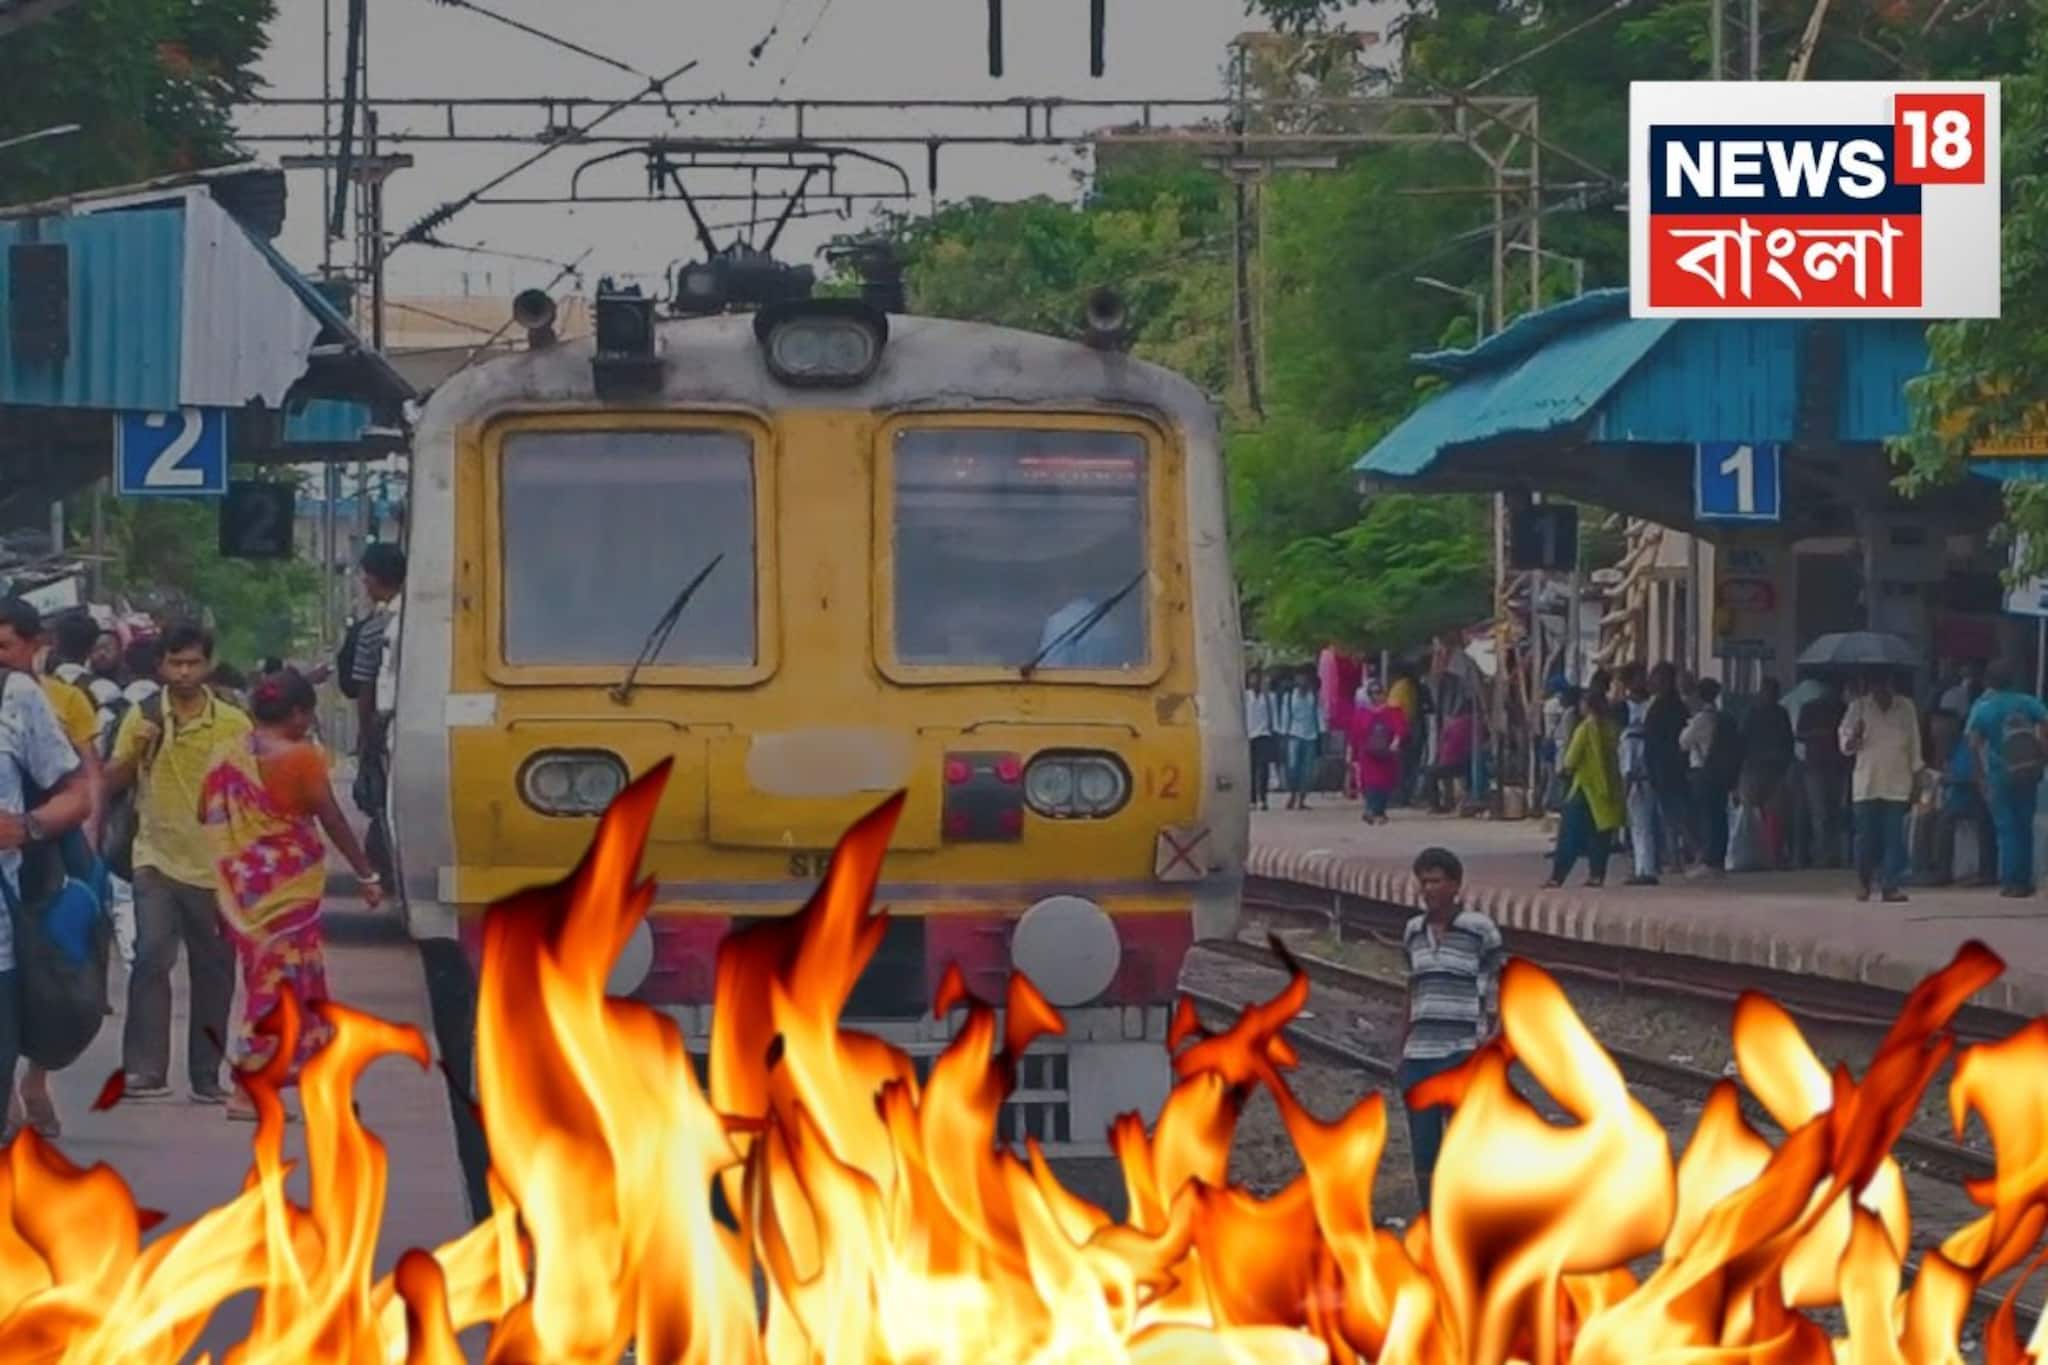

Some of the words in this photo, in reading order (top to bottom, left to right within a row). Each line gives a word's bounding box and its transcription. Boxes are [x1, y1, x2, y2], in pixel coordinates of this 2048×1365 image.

[144, 408, 204, 486] 2
[1719, 445, 1755, 513] 1
[1144, 764, 1180, 799] 12
